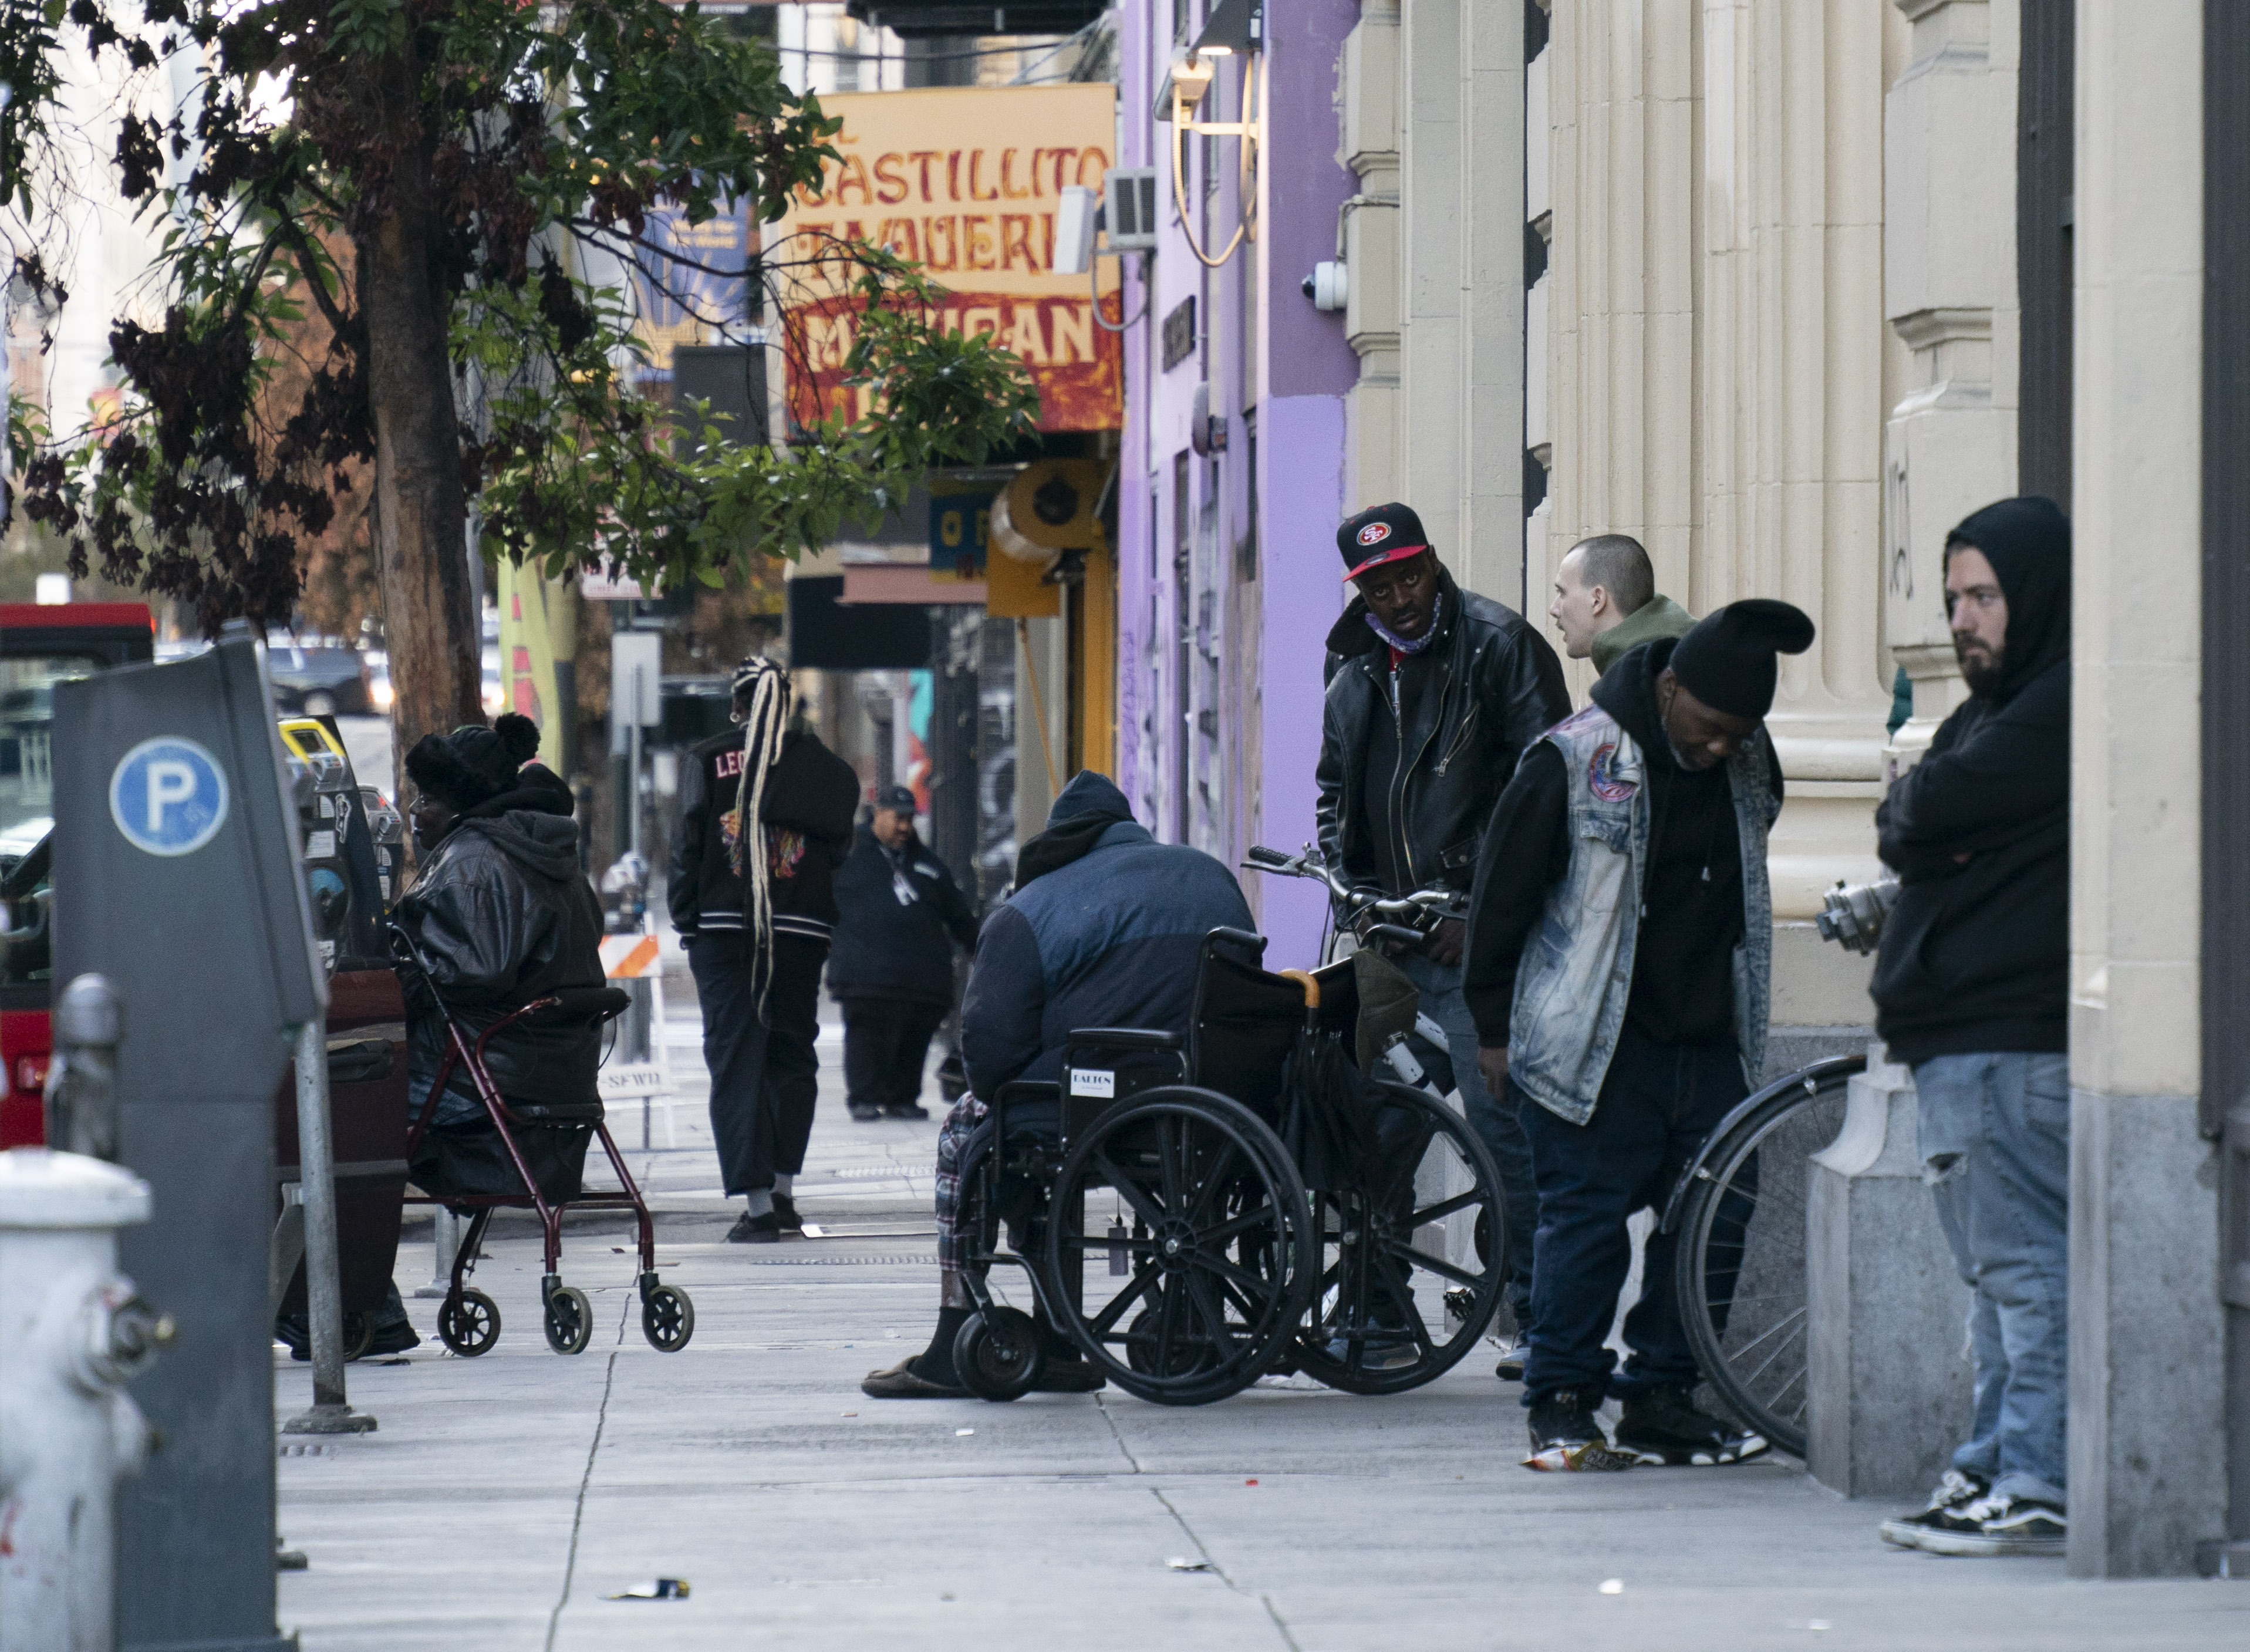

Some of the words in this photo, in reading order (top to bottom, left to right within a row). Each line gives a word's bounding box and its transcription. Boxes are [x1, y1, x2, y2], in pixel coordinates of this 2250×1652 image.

[797, 213, 1054, 279] TAQUERI
[804, 304, 1096, 373] MICAN
[147, 761, 198, 832] P
